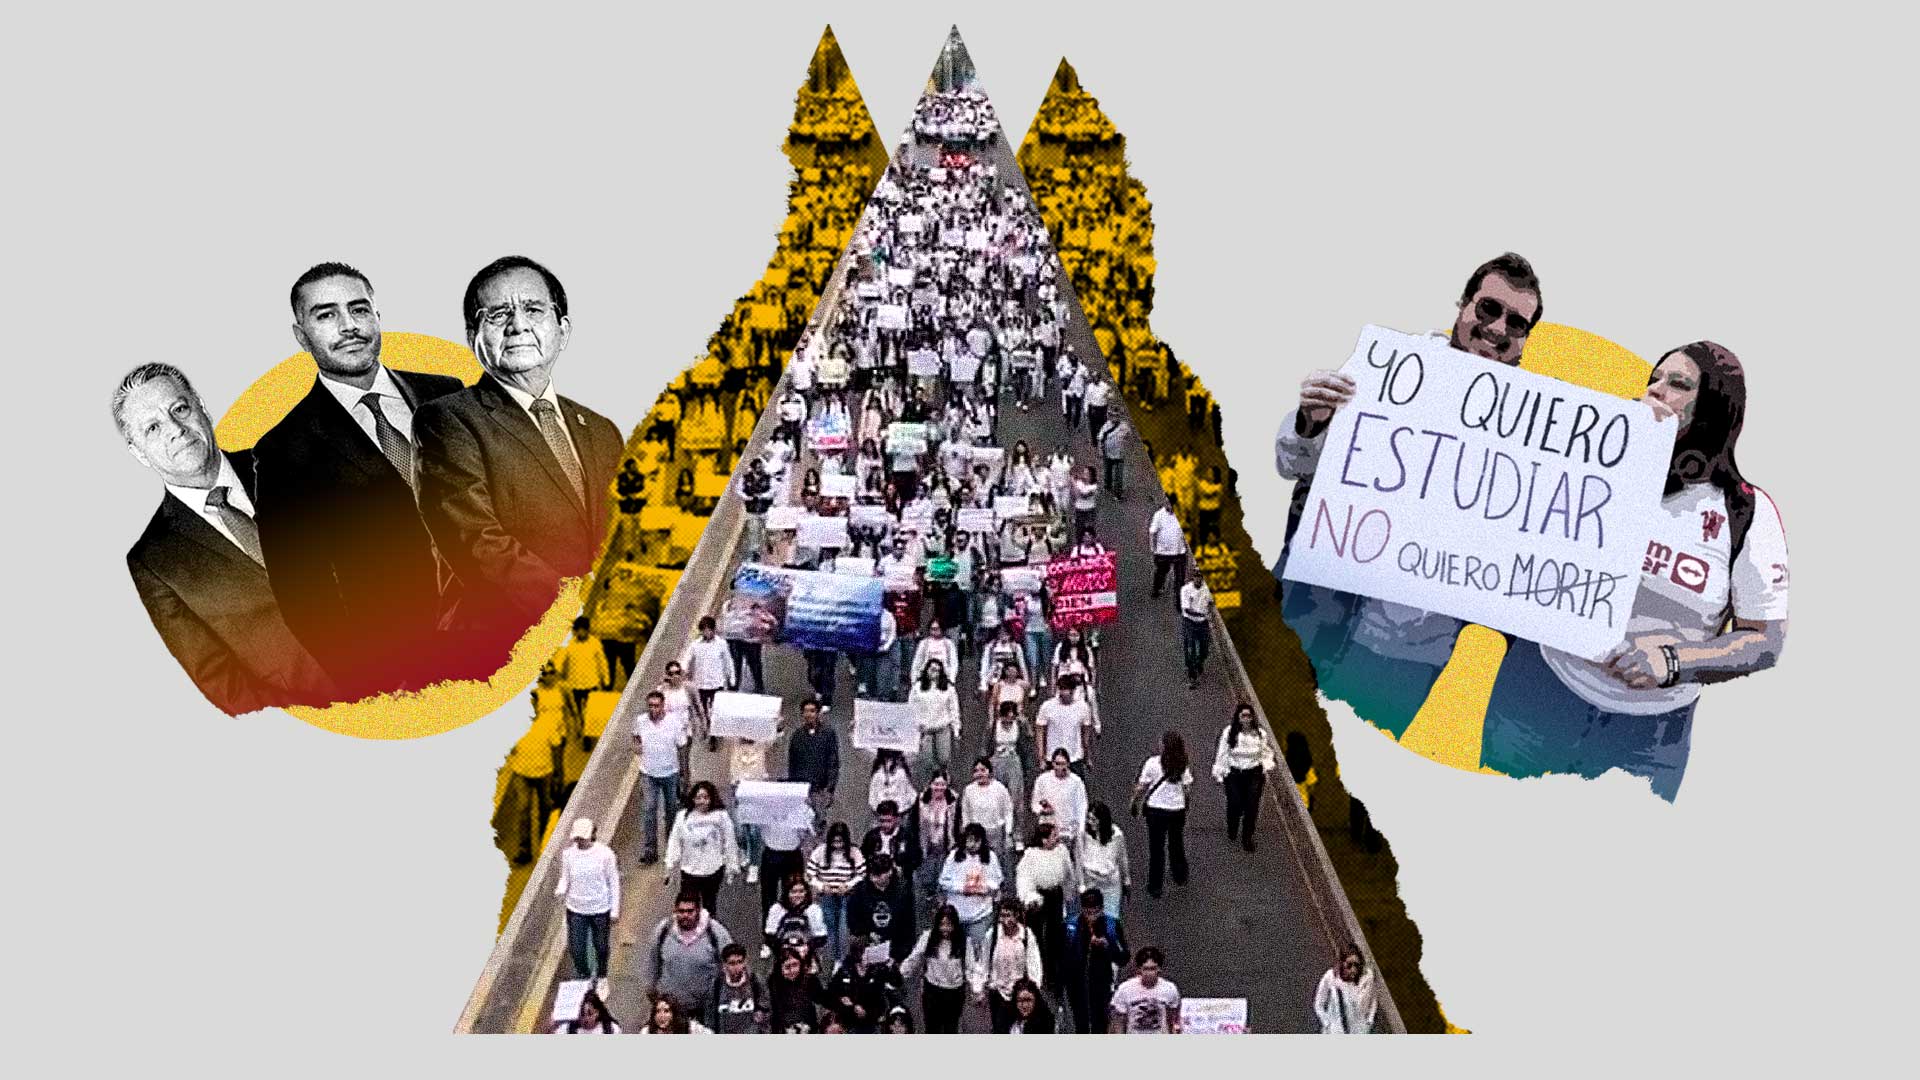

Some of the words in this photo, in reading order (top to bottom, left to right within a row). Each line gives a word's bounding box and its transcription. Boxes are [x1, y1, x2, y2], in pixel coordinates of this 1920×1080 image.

[1367, 339, 1425, 406] YO
[1460, 371, 1630, 469] QUIERO
[1340, 410, 1613, 549] ESTUDIAR
[1309, 497, 1392, 564] NO
[1397, 541, 1501, 591] QUIERO
[1504, 553, 1619, 628] MORIR
